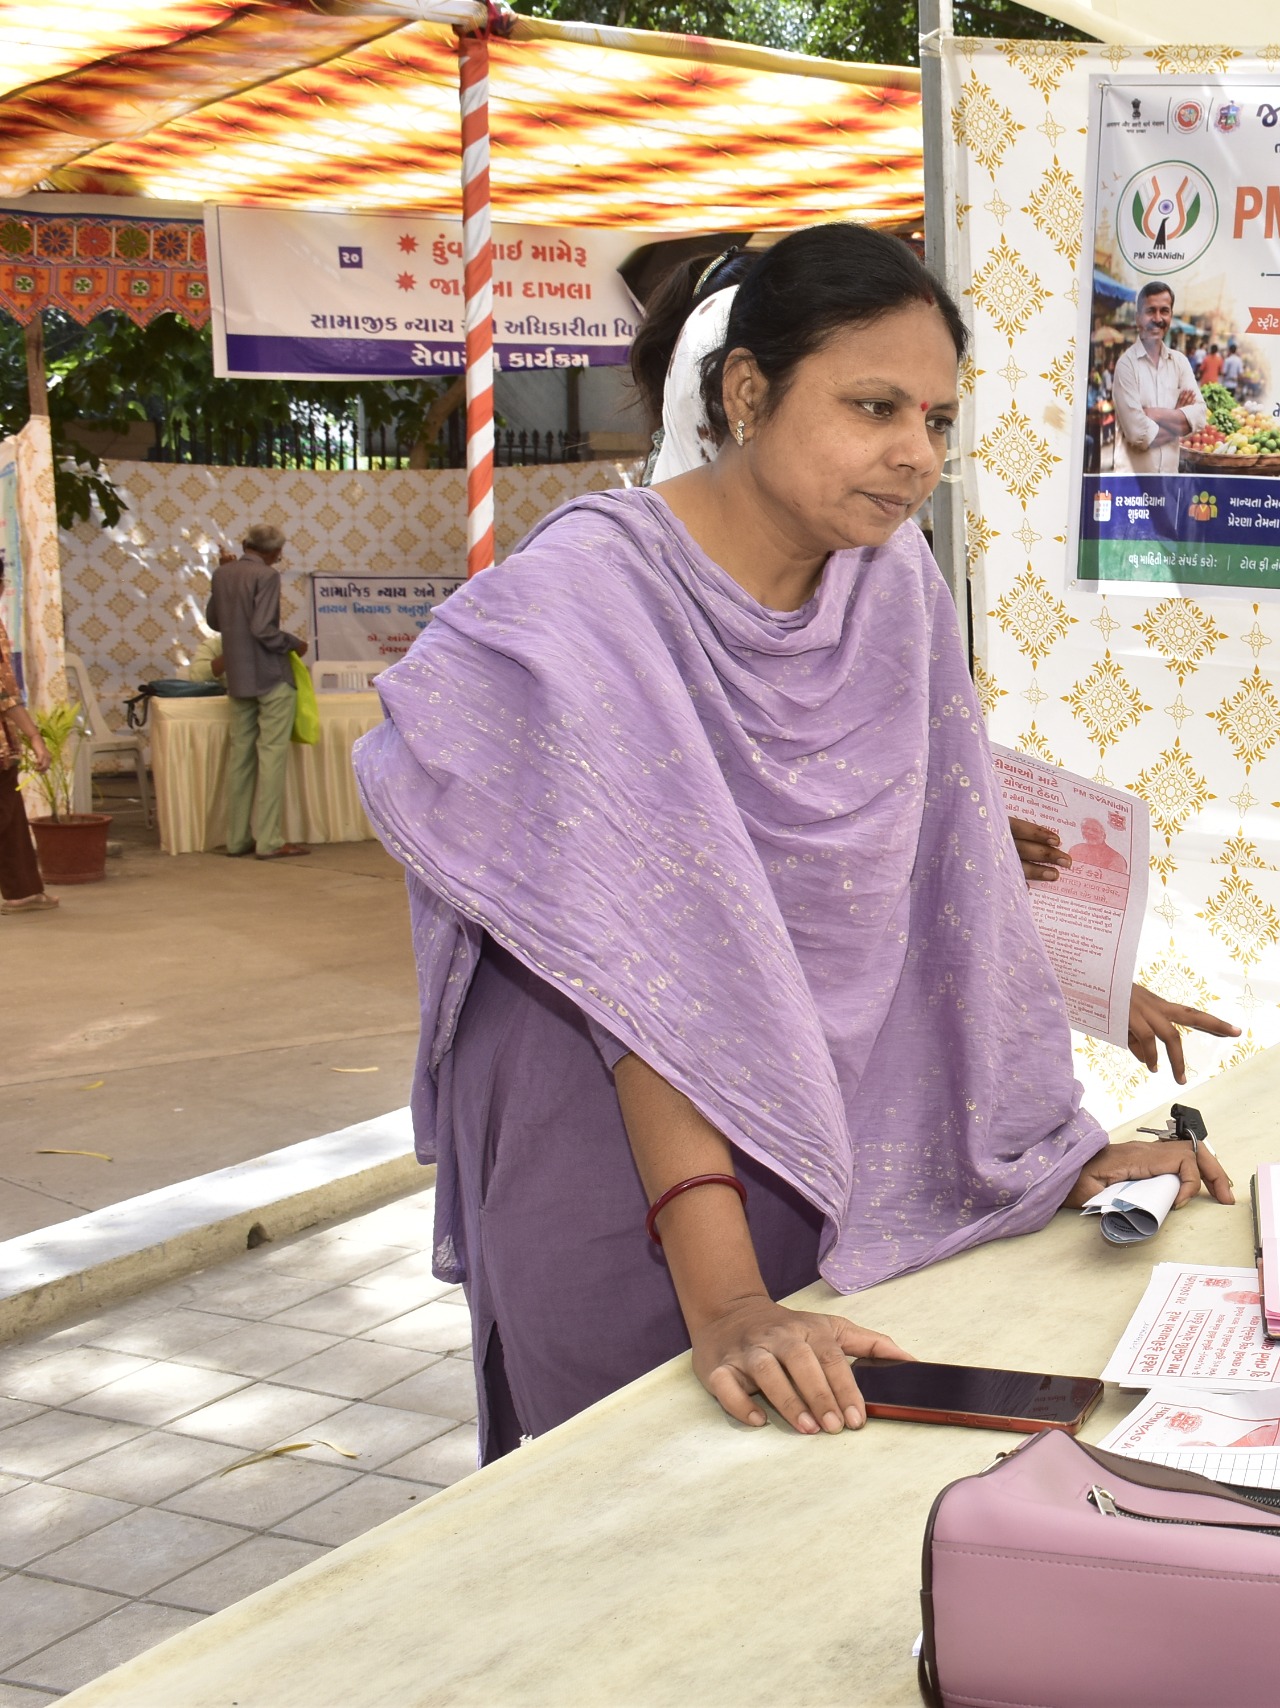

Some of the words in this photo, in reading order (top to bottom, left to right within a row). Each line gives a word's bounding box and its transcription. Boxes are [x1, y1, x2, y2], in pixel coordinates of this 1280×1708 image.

[1133, 251, 1145, 260] PM
[1147, 251, 1185, 260] SVANidhi
[522, 281, 592, 300] દાખલા
[310, 313, 398, 335] સામાજીક
[404, 318, 454, 333] ન્યાય
[504, 315, 607, 337] અધિકારીતા
[1229, 496, 1261, 508] માન્યતા
[1228, 513, 1252, 527] પ્રેરણા
[1254, 514, 1280, 529] તેમના
[1239, 556, 1257, 570] ટોલ
[319, 582, 371, 598] સામાજિક
[377, 586, 407, 598] ન્યાય
[412, 582, 437, 598] અને
[1003, 777, 1034, 793] યોજના
[1038, 774, 1059, 789] માટે
[1073, 786, 1087, 797] PM
[1089, 792, 1129, 813] SVANidhi
